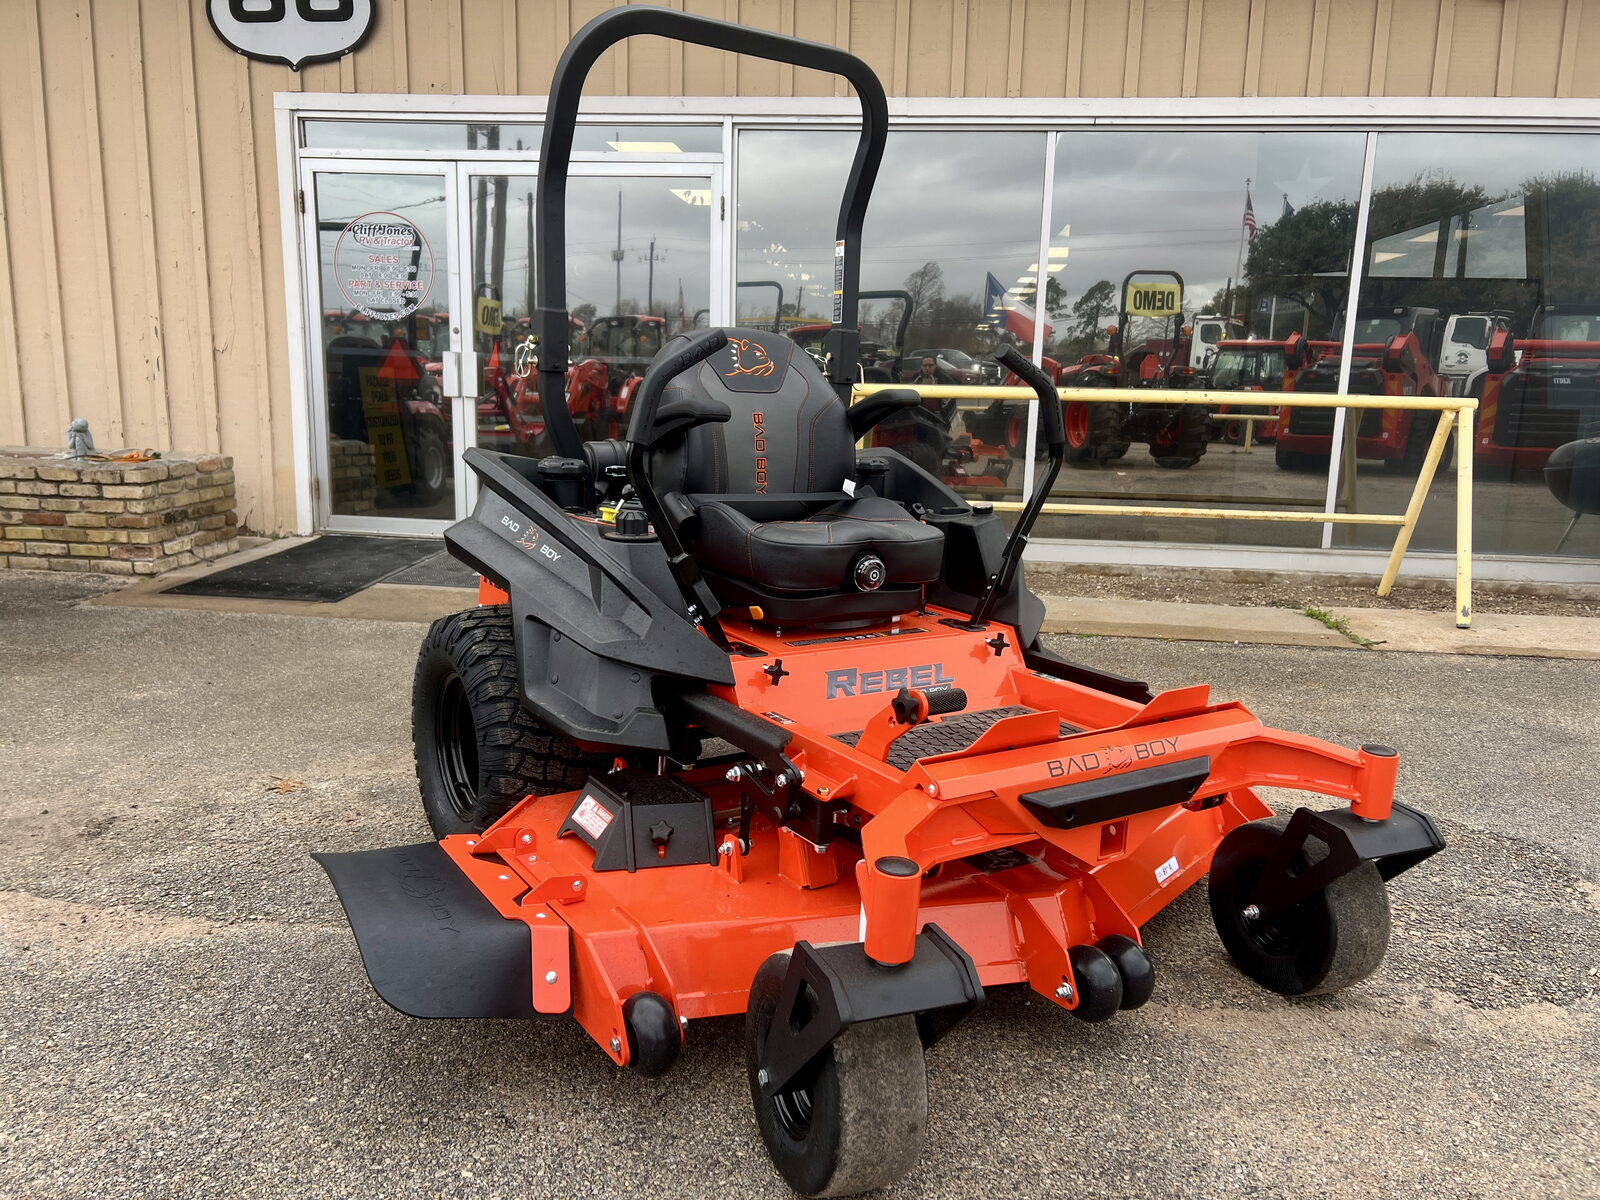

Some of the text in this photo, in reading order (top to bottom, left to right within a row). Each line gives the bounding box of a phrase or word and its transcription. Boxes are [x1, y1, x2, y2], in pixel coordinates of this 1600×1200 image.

[352, 224, 413, 237] Cliff Jones
[374, 237, 381, 245] &
[384, 237, 413, 245] Tractor
[368, 255, 399, 264] SALES
[348, 279, 424, 290] PART & SERVICE
[752, 412, 768, 495] BAD BOY
[501, 515, 562, 562] BAD BOY
[824, 663, 955, 699] REBEL
[1047, 736, 1178, 777] BAD BOY
